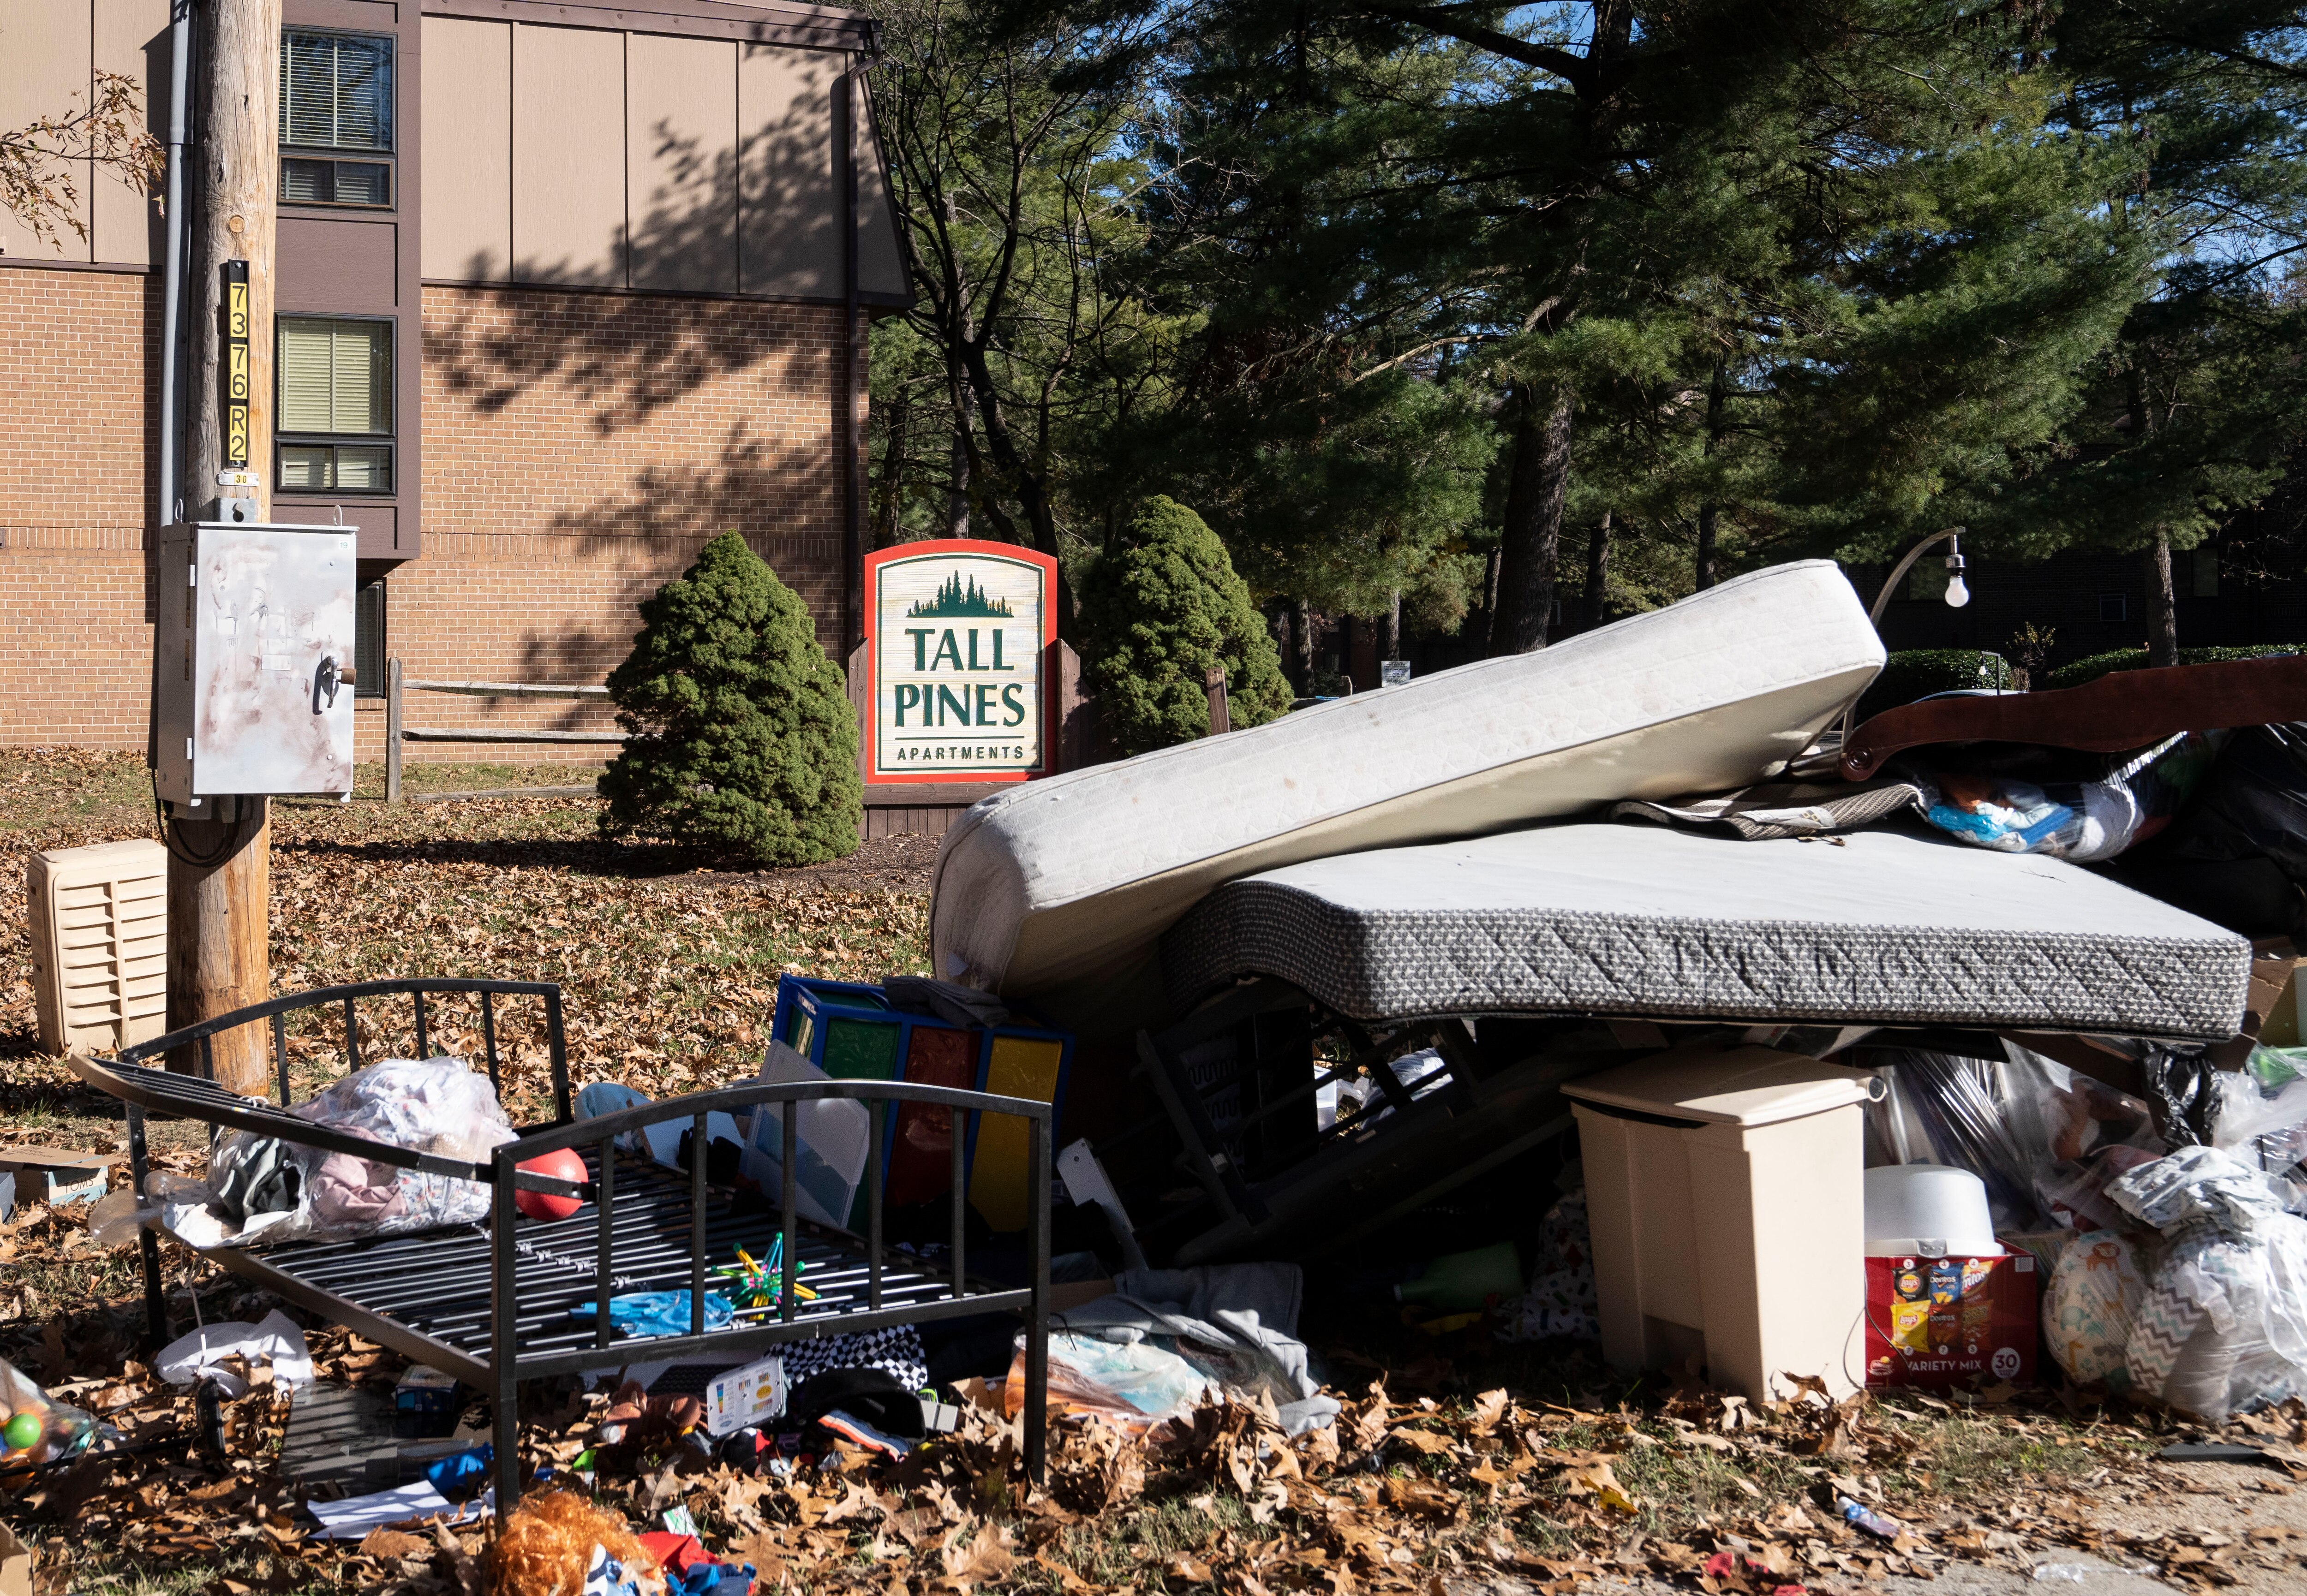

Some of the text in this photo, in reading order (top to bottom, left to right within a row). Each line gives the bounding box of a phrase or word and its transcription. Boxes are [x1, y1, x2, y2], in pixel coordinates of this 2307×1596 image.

[232, 285, 245, 458] 73 76 R2
[905, 628, 1015, 672] TALL
[895, 683, 1025, 727] PINES
[897, 746, 1023, 761] APARTMENTS
[64, 1175, 94, 1193] TOMS
[1907, 1360, 1982, 1371] VARIETY MIX
[1996, 1354, 2017, 1368] 30
